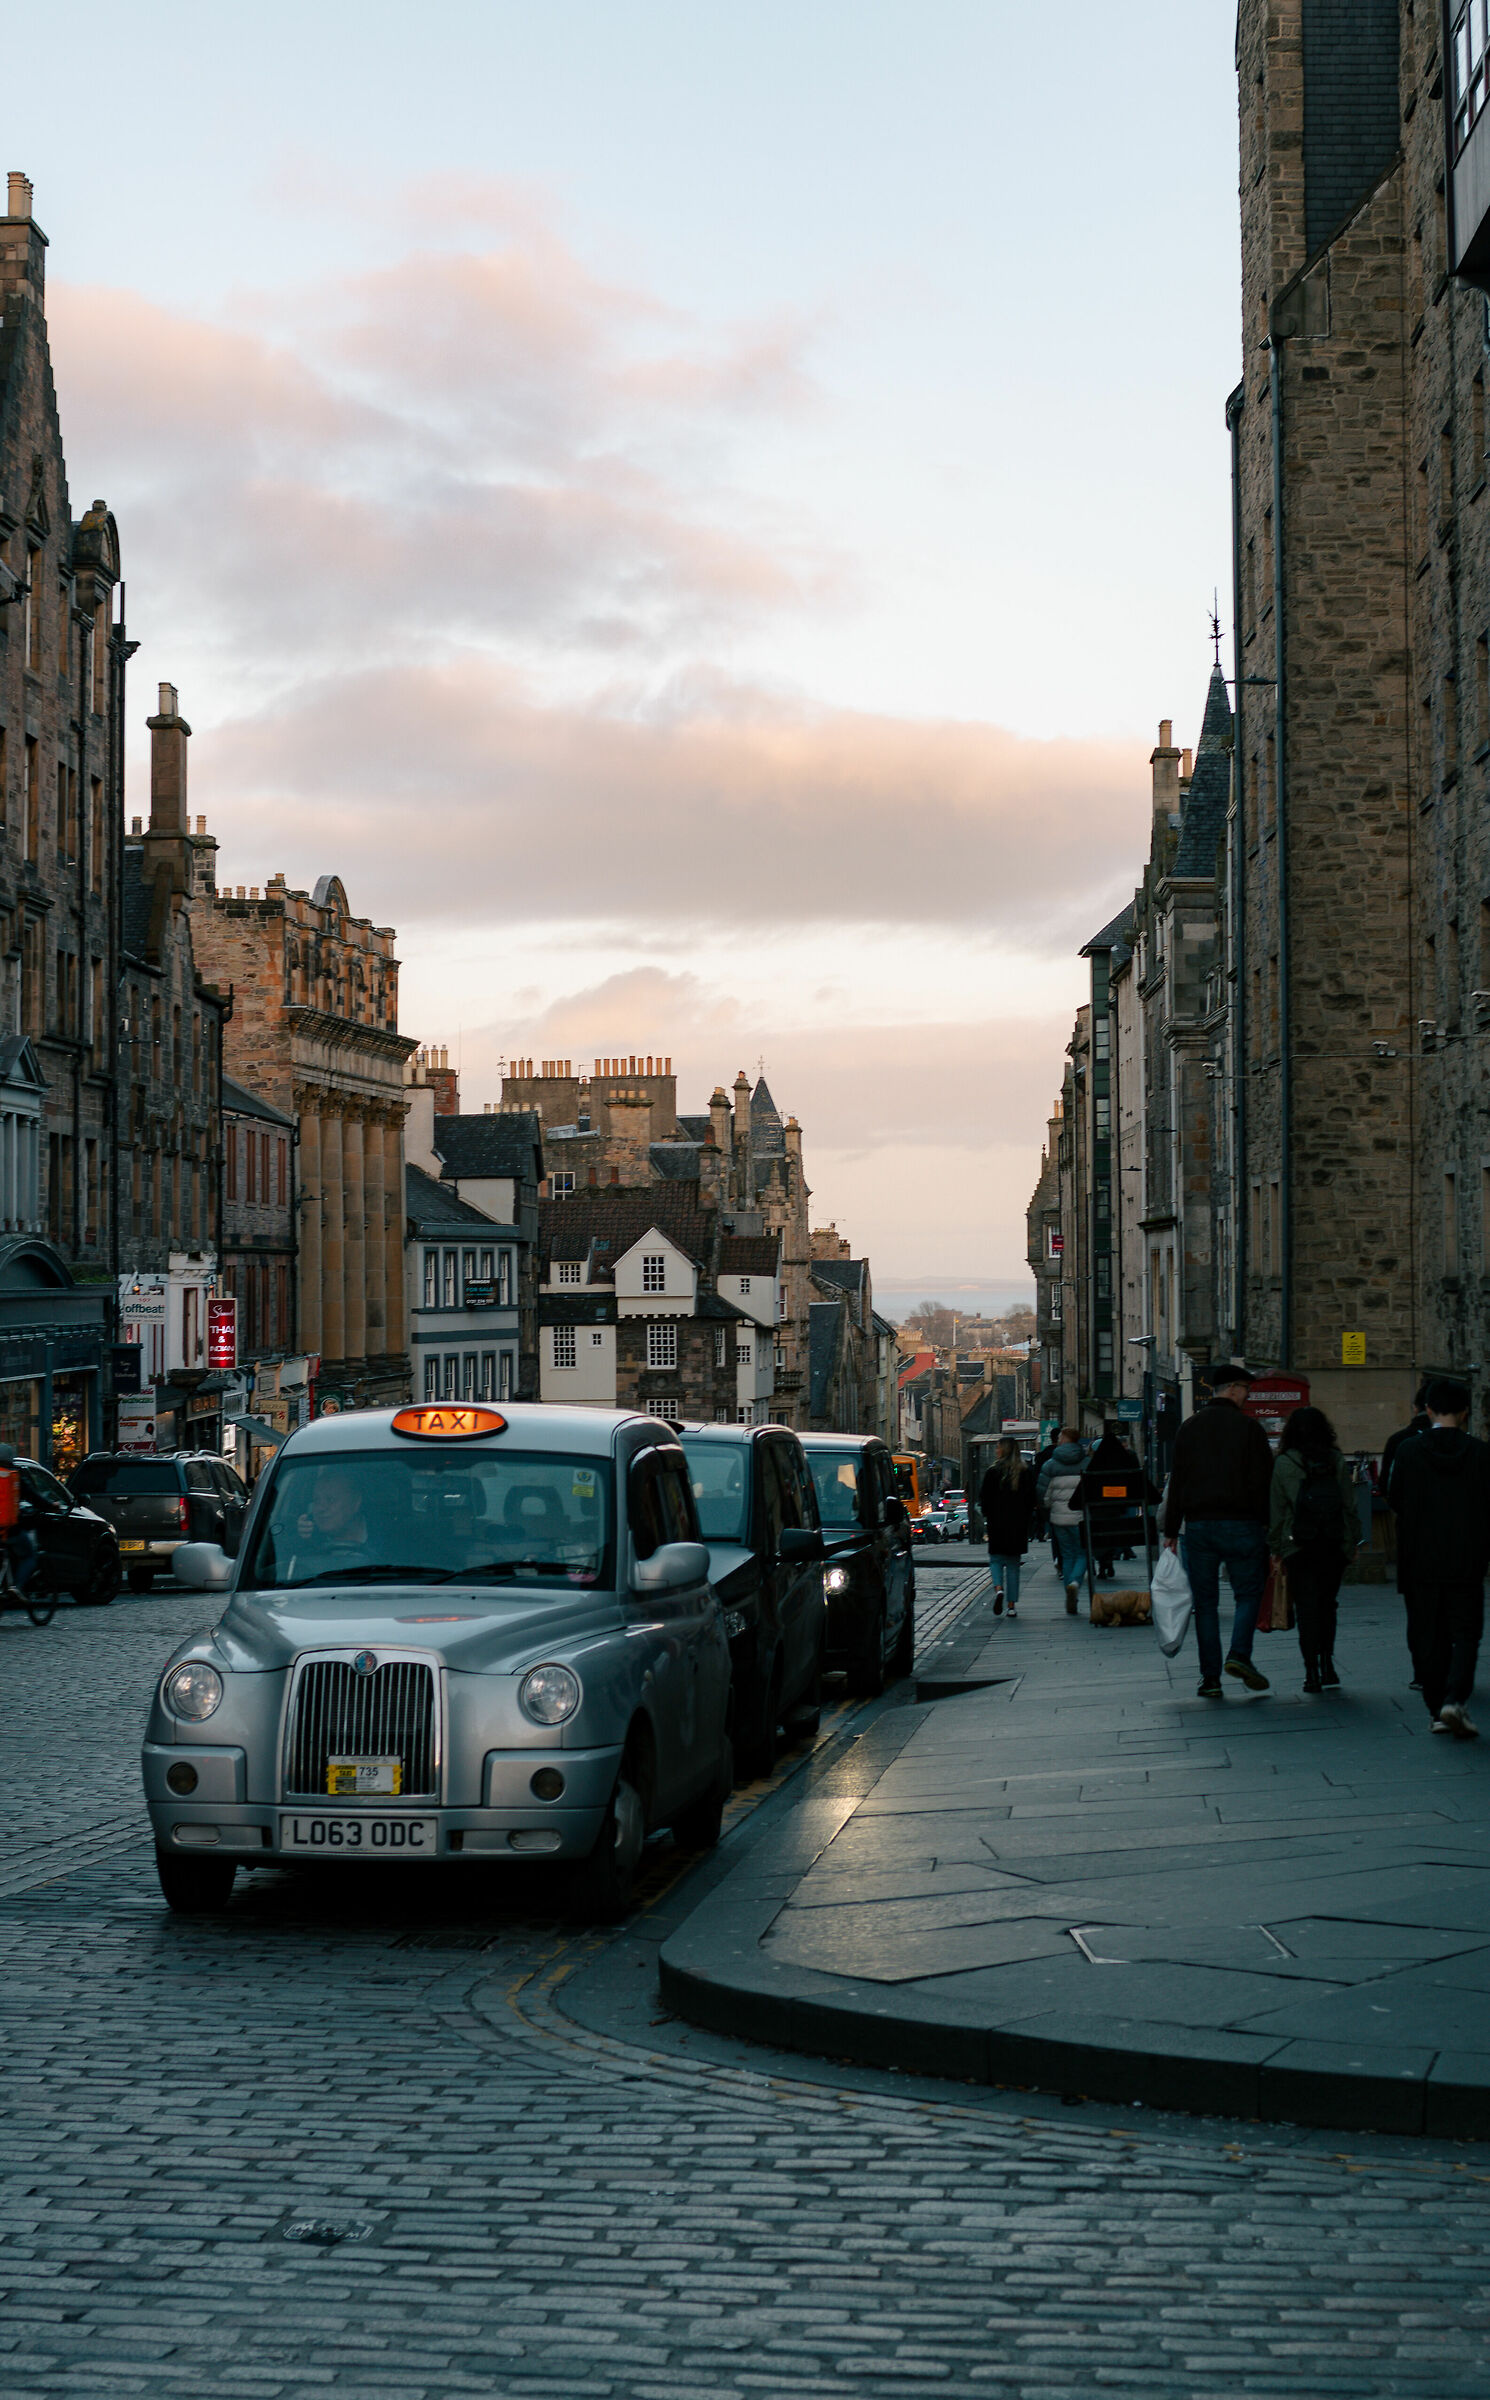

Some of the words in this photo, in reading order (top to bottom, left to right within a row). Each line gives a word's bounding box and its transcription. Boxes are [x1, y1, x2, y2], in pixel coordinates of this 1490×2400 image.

[209, 1325, 235, 1334] THAI
[217, 1335, 226, 1344] &
[413, 1413, 478, 1430] TAXI
[359, 1766, 379, 1777] 735
[294, 1820, 362, 1845] LO63
[372, 1822, 424, 1846] ODC
